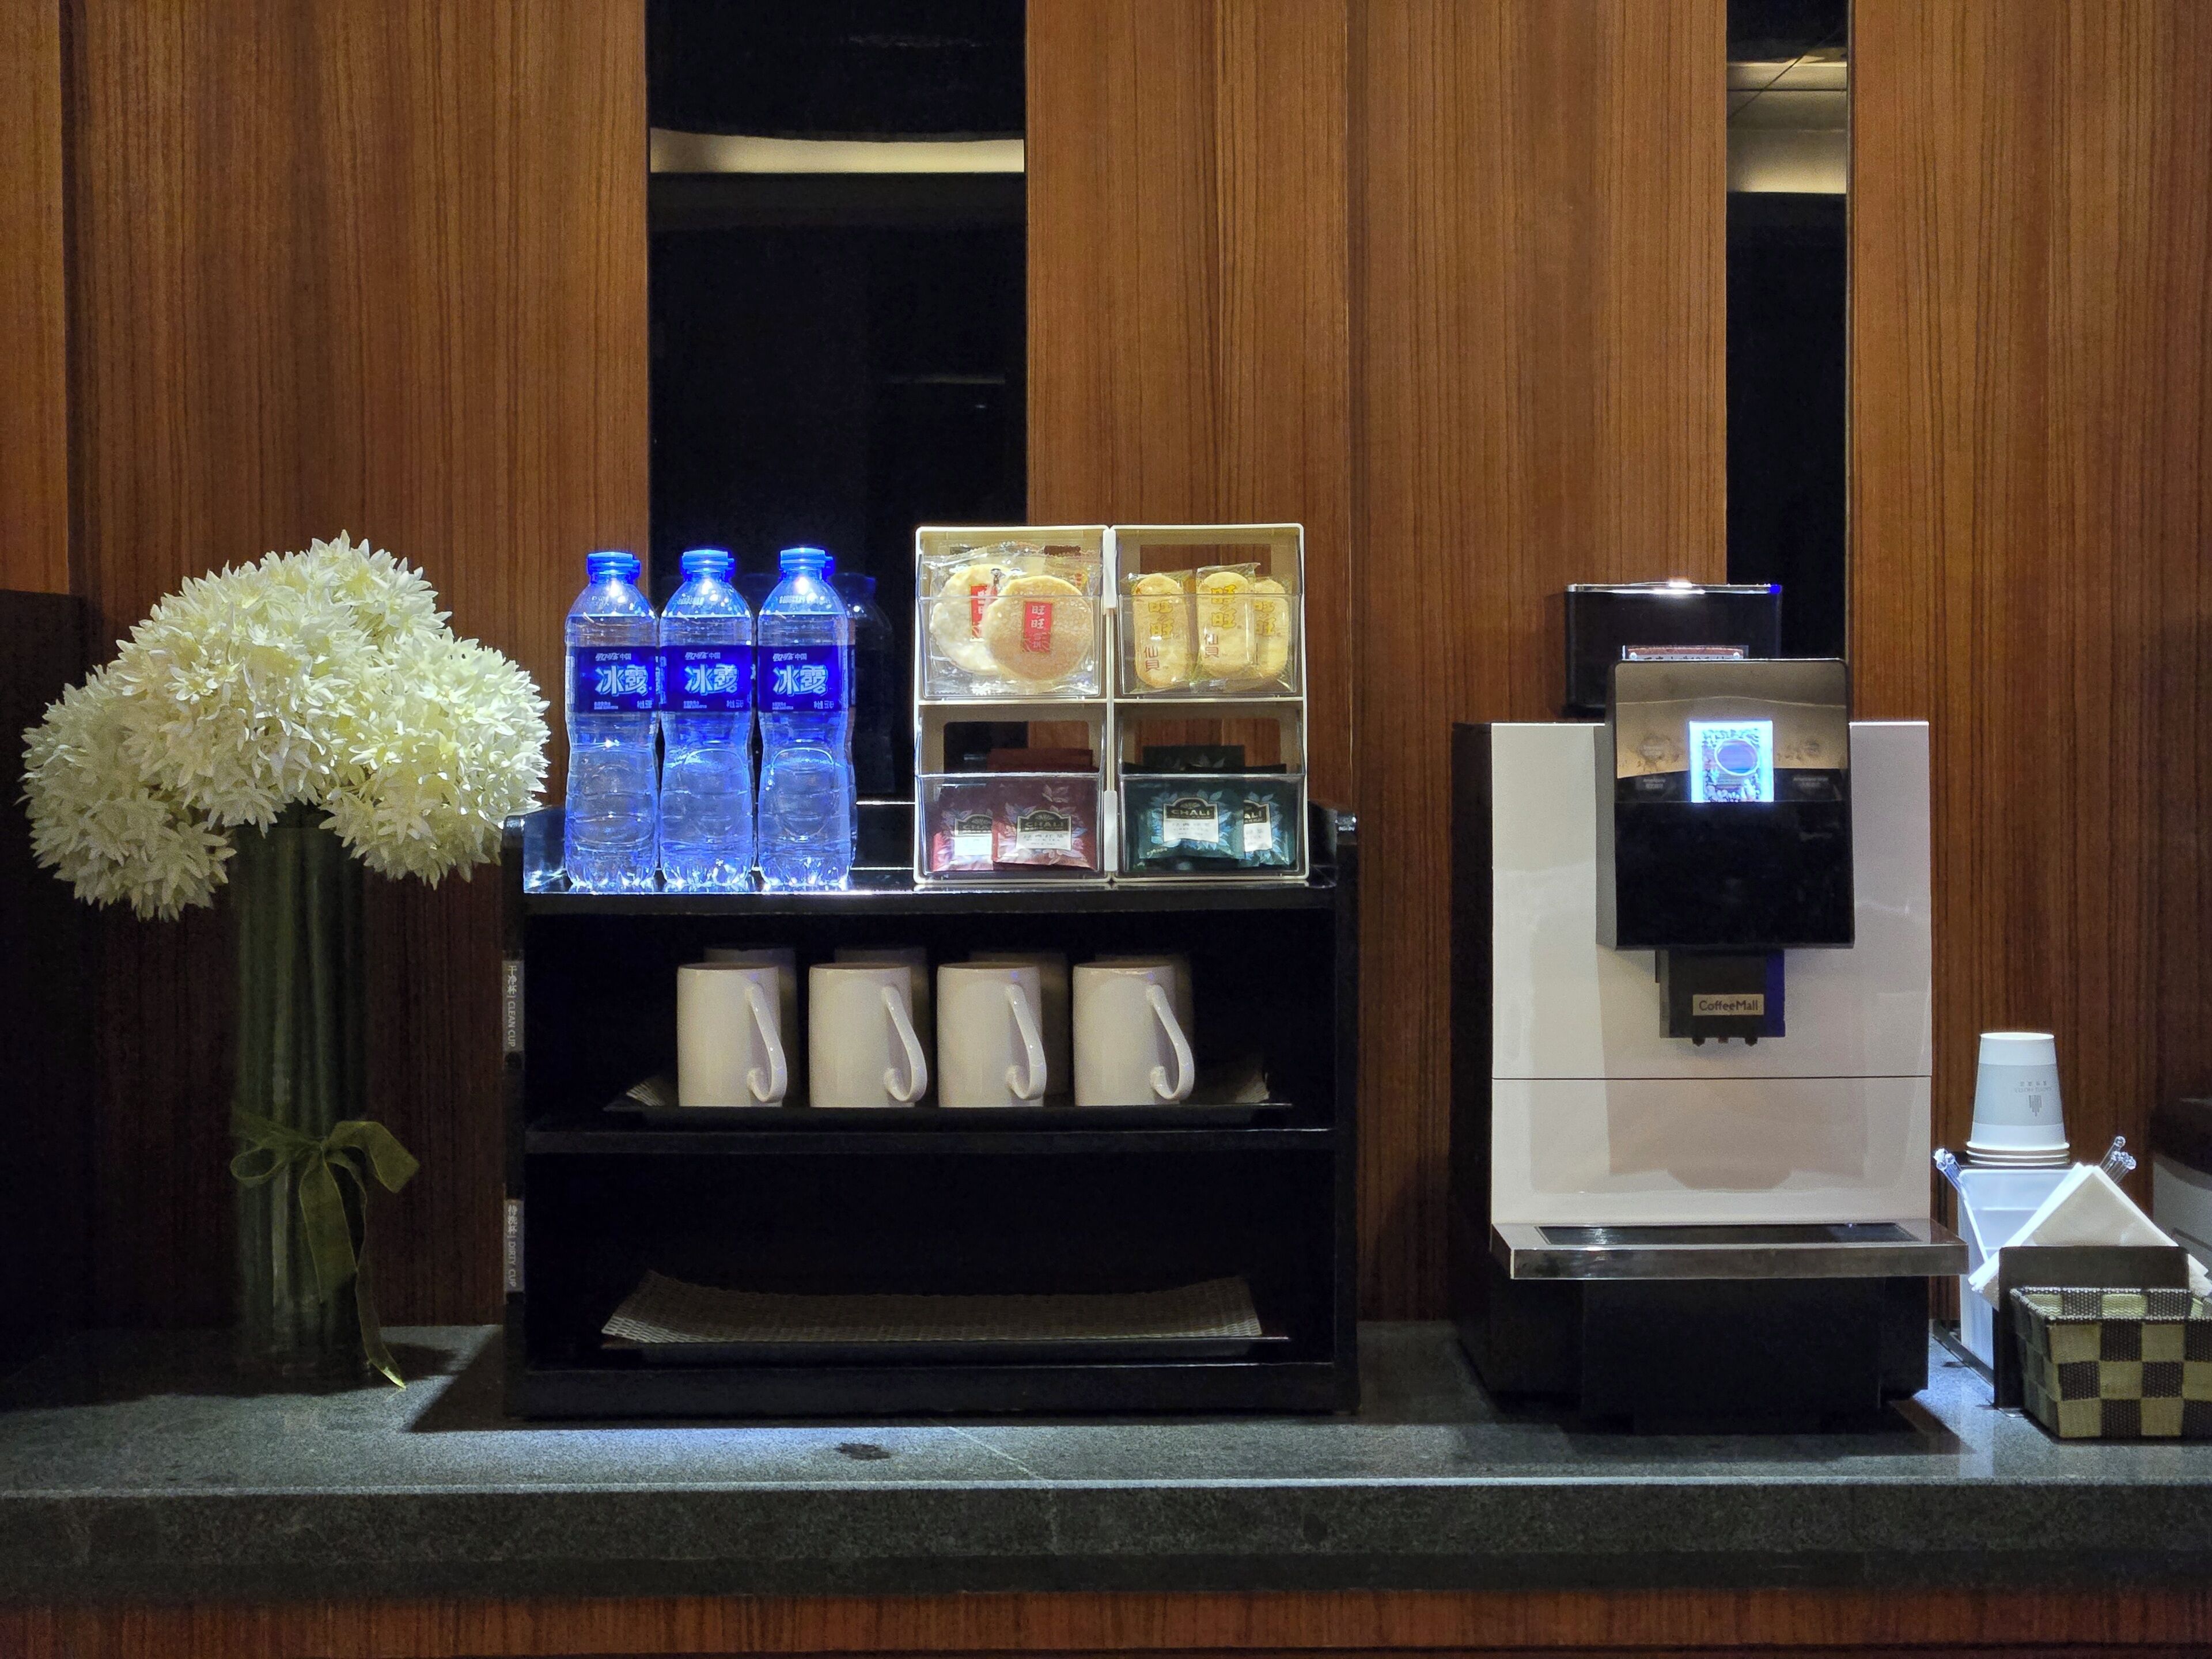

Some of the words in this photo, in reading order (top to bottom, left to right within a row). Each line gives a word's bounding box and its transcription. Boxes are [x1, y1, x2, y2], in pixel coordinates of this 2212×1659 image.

[1031, 605, 1046, 630] 旺旺
[1148, 599, 1174, 639] 旺旺
[1211, 584, 1237, 628] 旺旺
[595, 664, 649, 696] 冰露
[684, 663, 739, 696] 冰露
[772, 665, 828, 696] 冰露
[507, 1001, 516, 1028] CLEAN
[1699, 999, 1759, 1011] CoffeeMall
[507, 1029, 516, 1047] CUP
[508, 1241, 516, 1265] DIRTY
[508, 1269, 517, 1287] CUP
